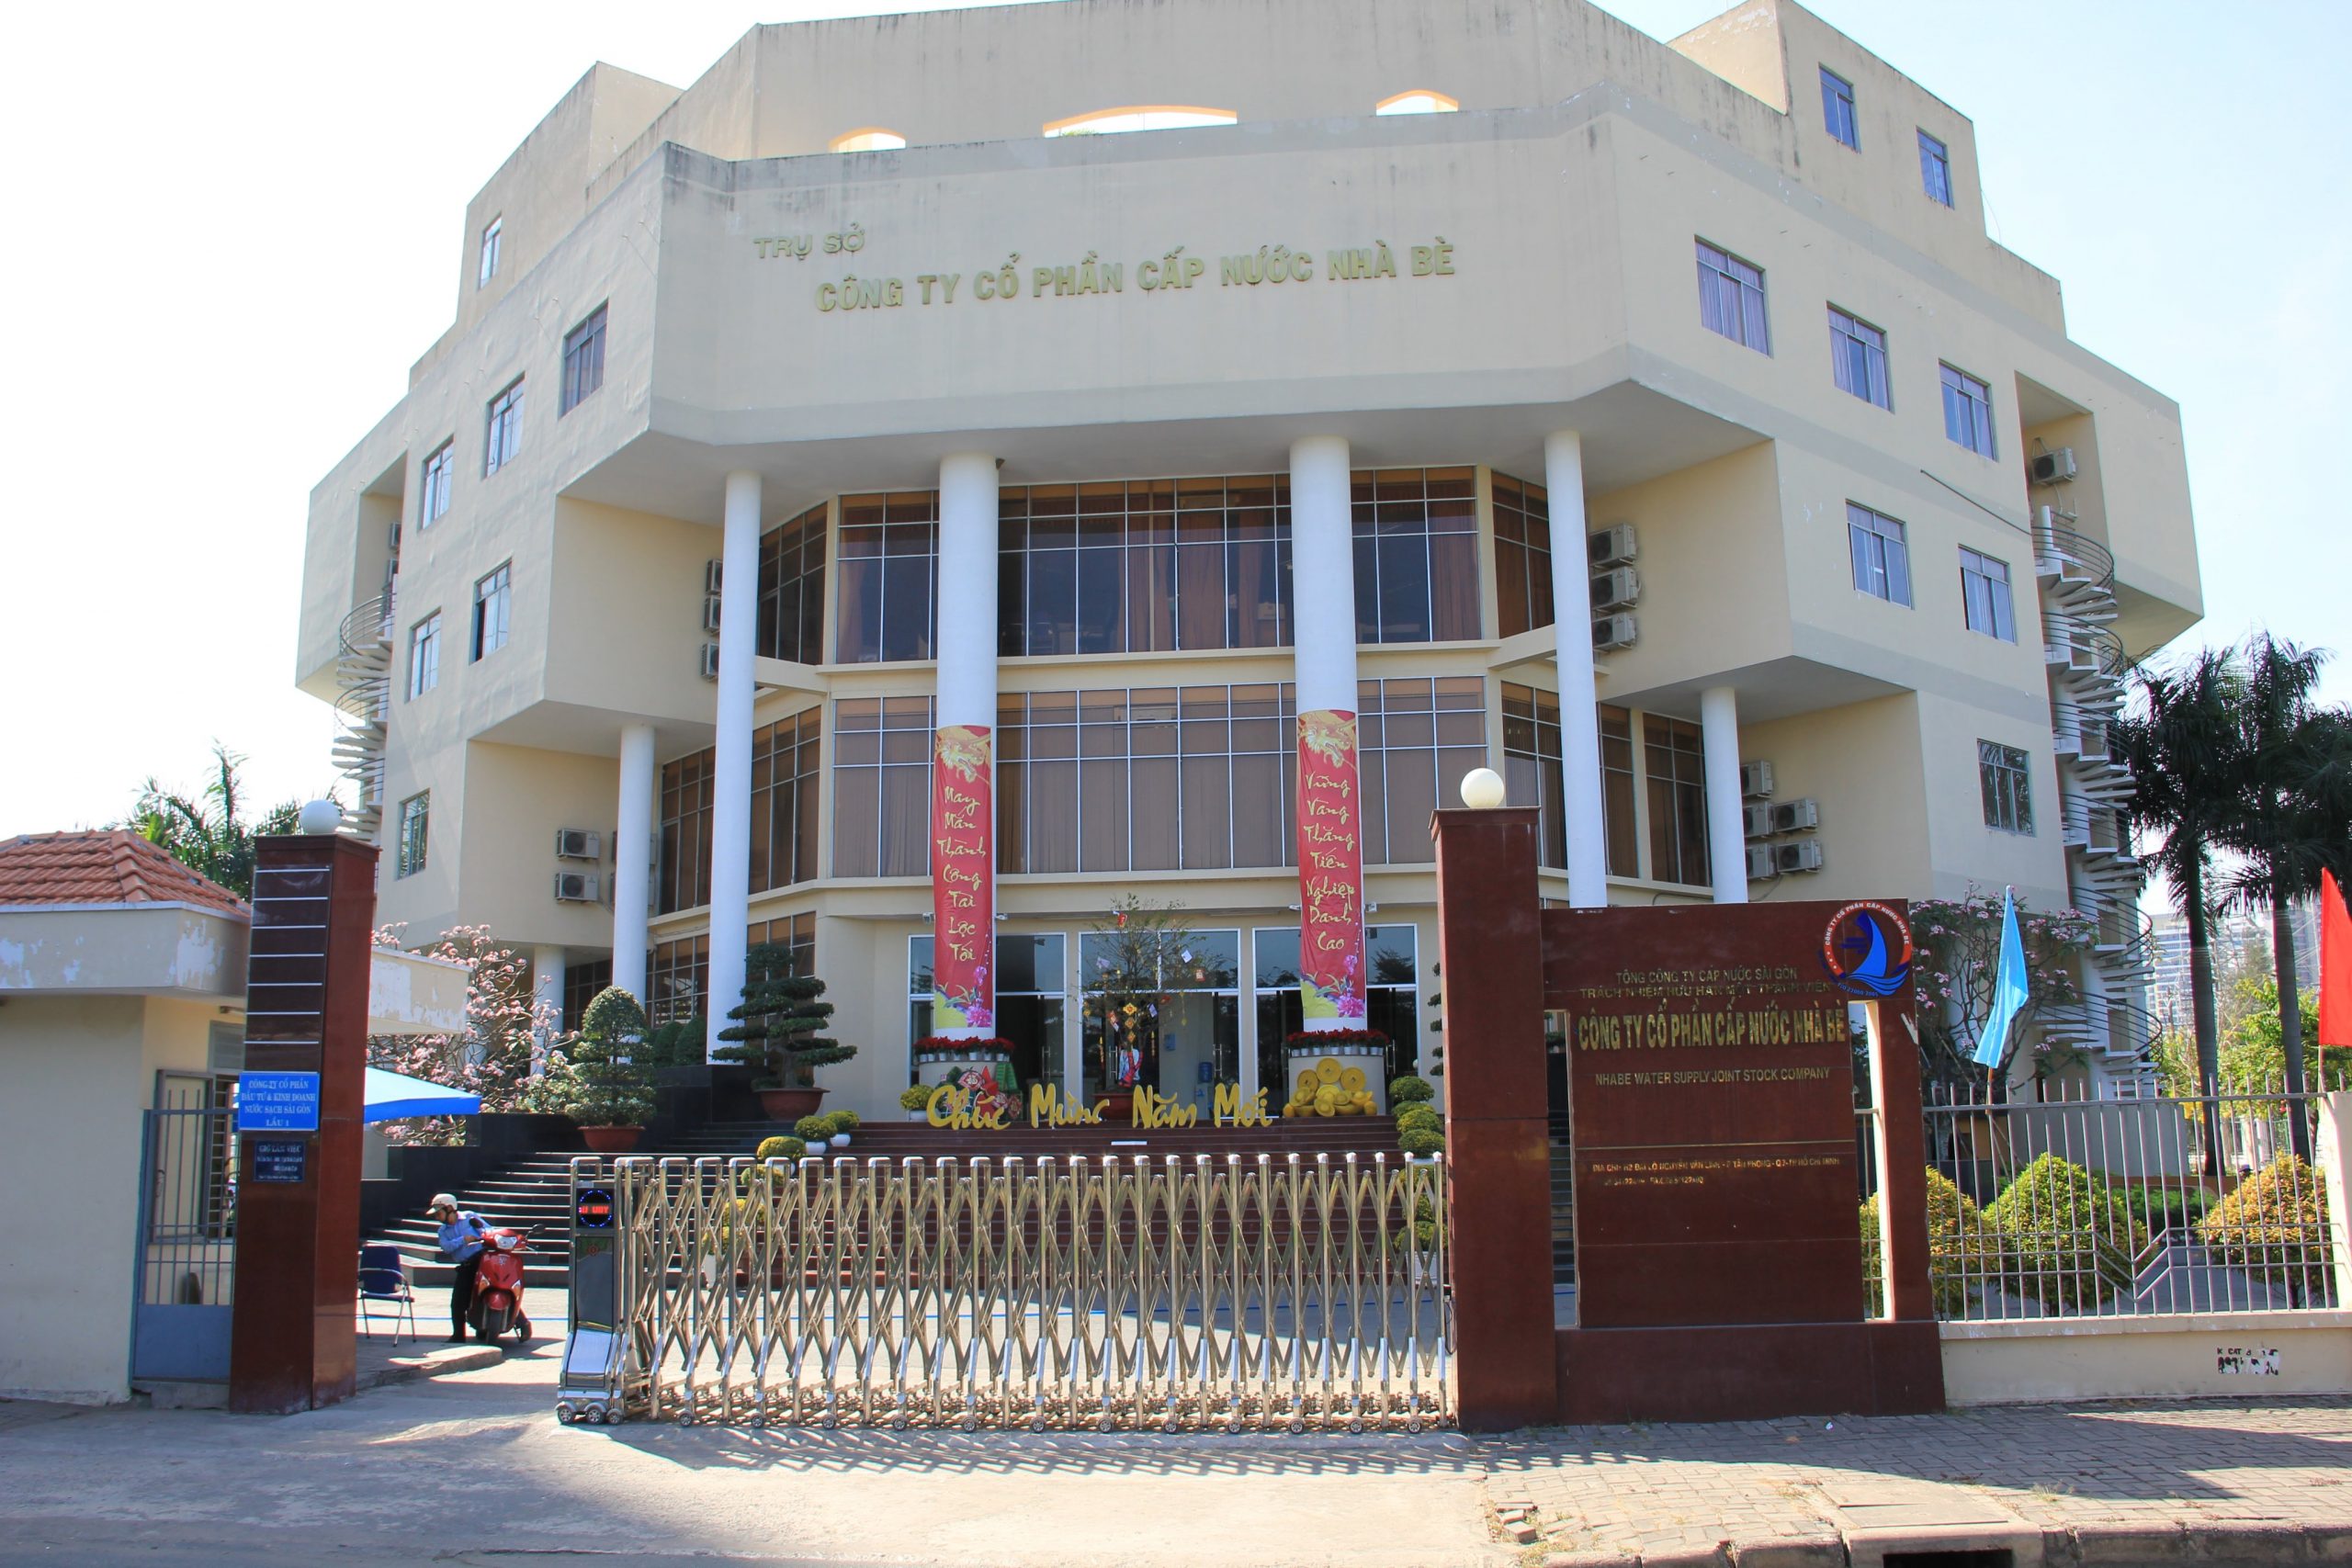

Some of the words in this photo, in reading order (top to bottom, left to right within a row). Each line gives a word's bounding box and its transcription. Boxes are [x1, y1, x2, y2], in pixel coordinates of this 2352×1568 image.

[753, 233, 812, 261] TRỤ
[822, 221, 865, 254] SỞ
[815, 274, 903, 312] CÔNG
[918, 274, 961, 305] TY
[974, 251, 1020, 299] CỔ
[1033, 250, 1123, 297] PHẦN
[1136, 245, 1204, 290] CẤP
[1220, 244, 1312, 286] NƯỚC
[1328, 240, 1396, 280] NHÀ
[1411, 235, 1454, 276] BÈ
[944, 785, 980, 817] May
[1307, 796, 1350, 825] Vàng
[944, 806, 977, 829] Mắn
[936, 836, 986, 859] Thành
[1303, 822, 1355, 852] Thăng
[1310, 847, 1348, 869] Tiến
[943, 863, 982, 891] Công
[948, 890, 977, 908] Tài
[1306, 875, 1355, 911] Nghiệp
[1309, 902, 1351, 926] Danh
[948, 916, 977, 938] Lộc
[1317, 931, 1345, 952] Cao
[1648, 968, 1679, 983] CÔNG
[1682, 970, 1695, 982] TY
[1755, 964, 1771, 980] SÀI
[1580, 985, 1621, 999] TRÁCH
[1578, 1007, 1621, 1050] CÔNG
[1623, 1015, 1643, 1048] TY
[1646, 998, 1667, 1048] CỔ
[1670, 998, 1713, 1047] PHẦN
[1714, 995, 1746, 1045] CẤP
[1748, 999, 1790, 1045] NƯỚC
[1793, 1000, 1824, 1043] NHÀ
[1826, 999, 1846, 1043] BÈ
[1596, 1073, 1631, 1085] NHABE
[1634, 1072, 1670, 1084] WATER
[1674, 1070, 1710, 1083] SUPPLY
[1712, 1069, 1741, 1082] JOINT
[1744, 1068, 1778, 1081] STOCK
[1781, 1066, 1830, 1080] COMPANY
[926, 1084, 1012, 1131] Chúc
[1132, 1084, 1197, 1129] Năm
[1214, 1082, 1273, 1128] Mới
